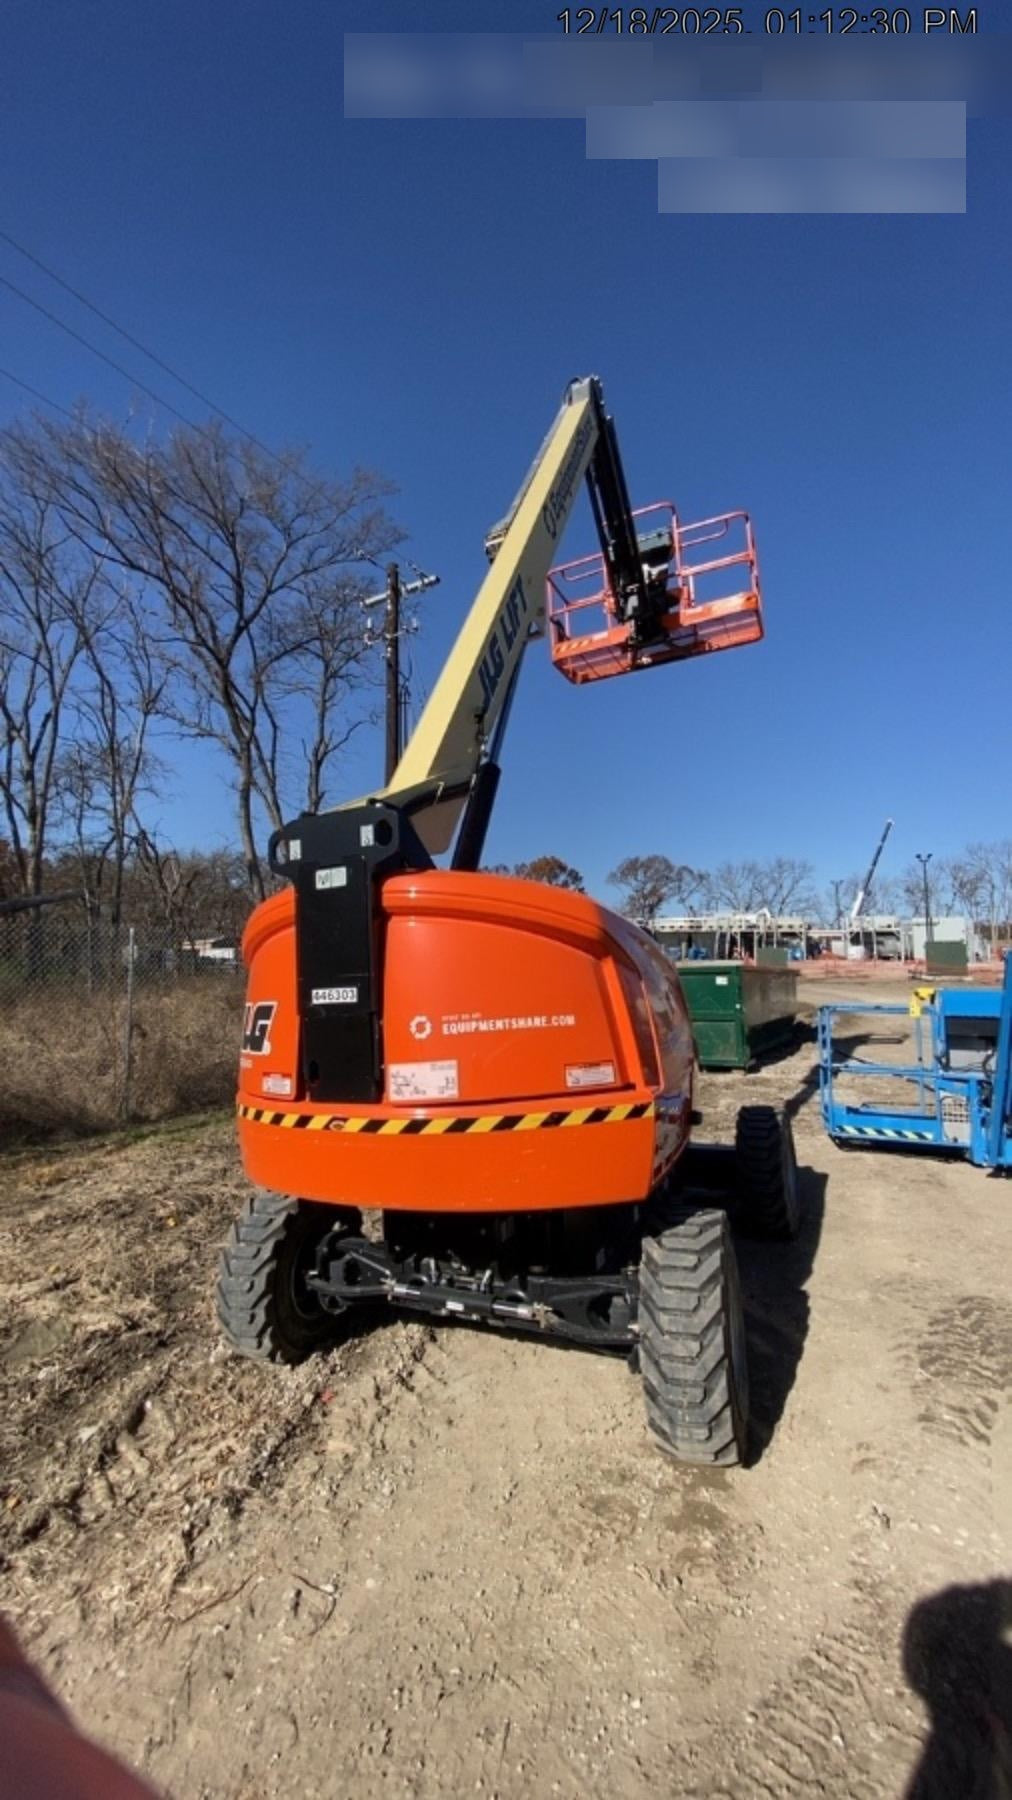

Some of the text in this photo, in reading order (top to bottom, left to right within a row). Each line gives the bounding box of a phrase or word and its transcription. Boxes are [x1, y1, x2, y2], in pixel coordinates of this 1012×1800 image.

[478, 571, 528, 712] JLG LIFT
[241, 1001, 278, 1055] LG
[442, 1014, 576, 1035] EQUIPMENTSHARE.COM
